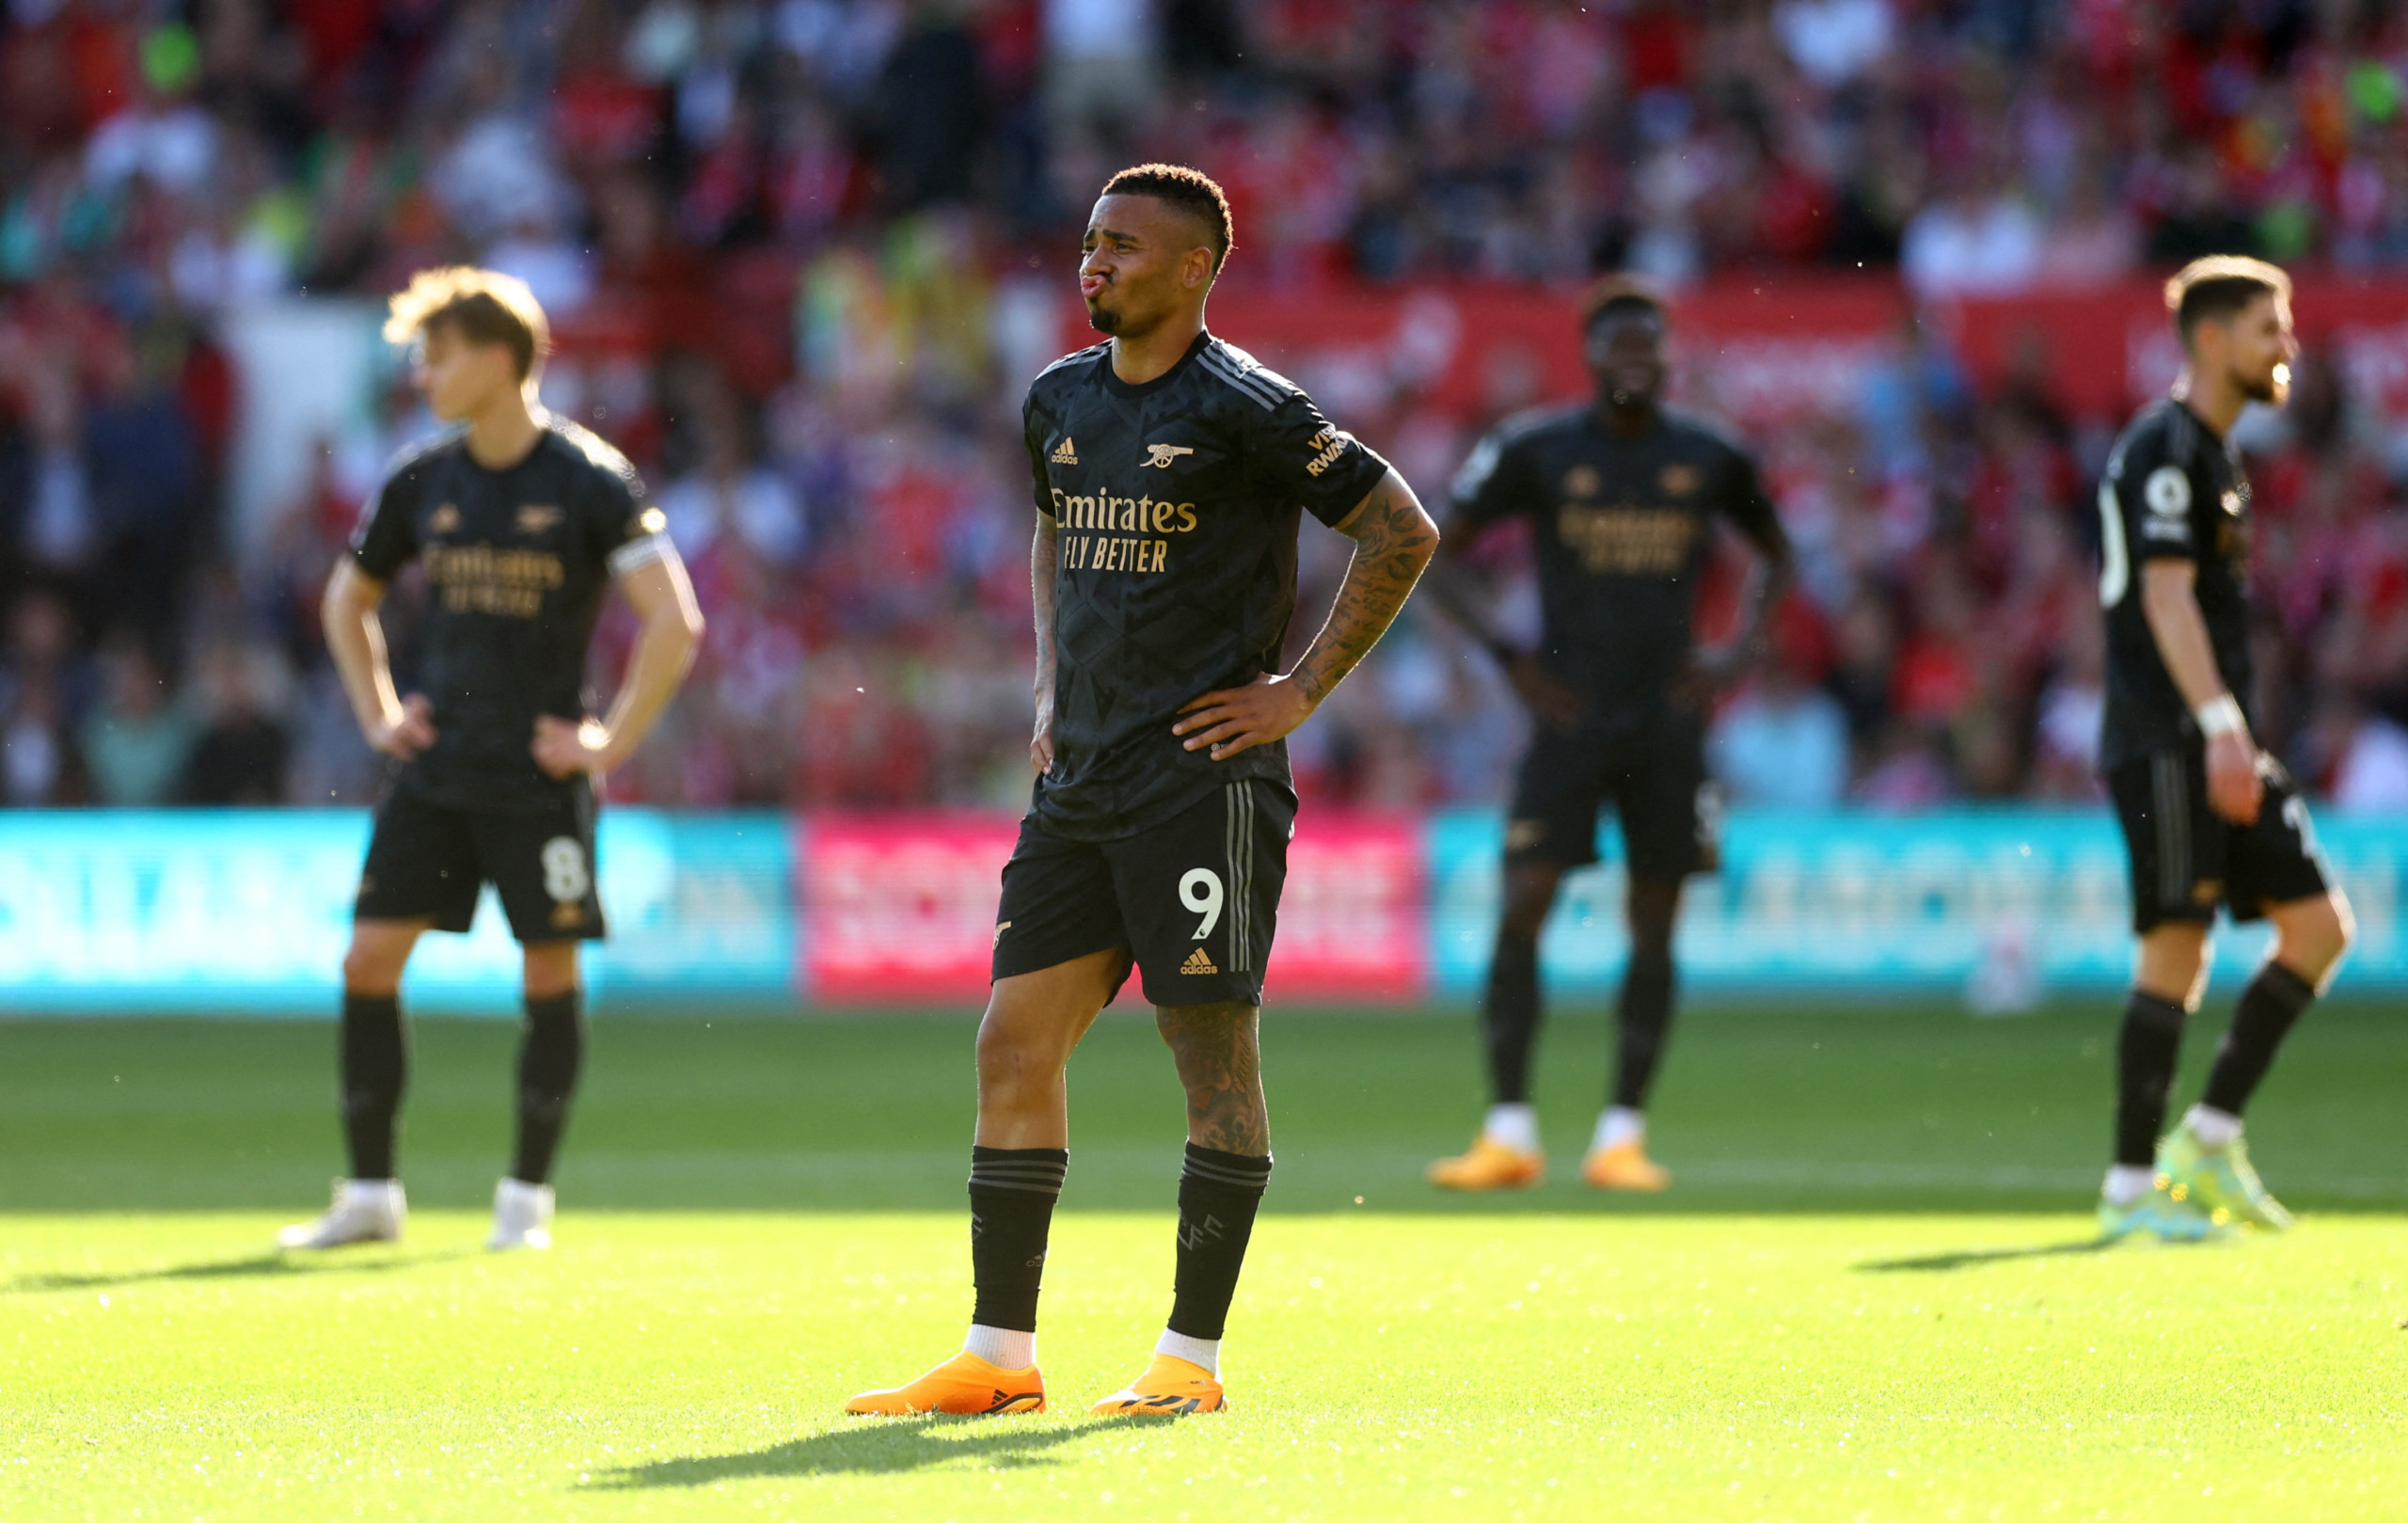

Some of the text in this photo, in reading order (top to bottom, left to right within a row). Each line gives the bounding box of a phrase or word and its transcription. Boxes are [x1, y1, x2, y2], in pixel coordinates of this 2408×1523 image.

[1051, 453, 1079, 466] adidas
[1051, 486, 1197, 533] Emirates
[1064, 536, 1167, 573] FLY BETTER
[542, 835, 590, 902] 8
[1178, 867, 1224, 940] 9
[1180, 962, 1218, 975] adidas
